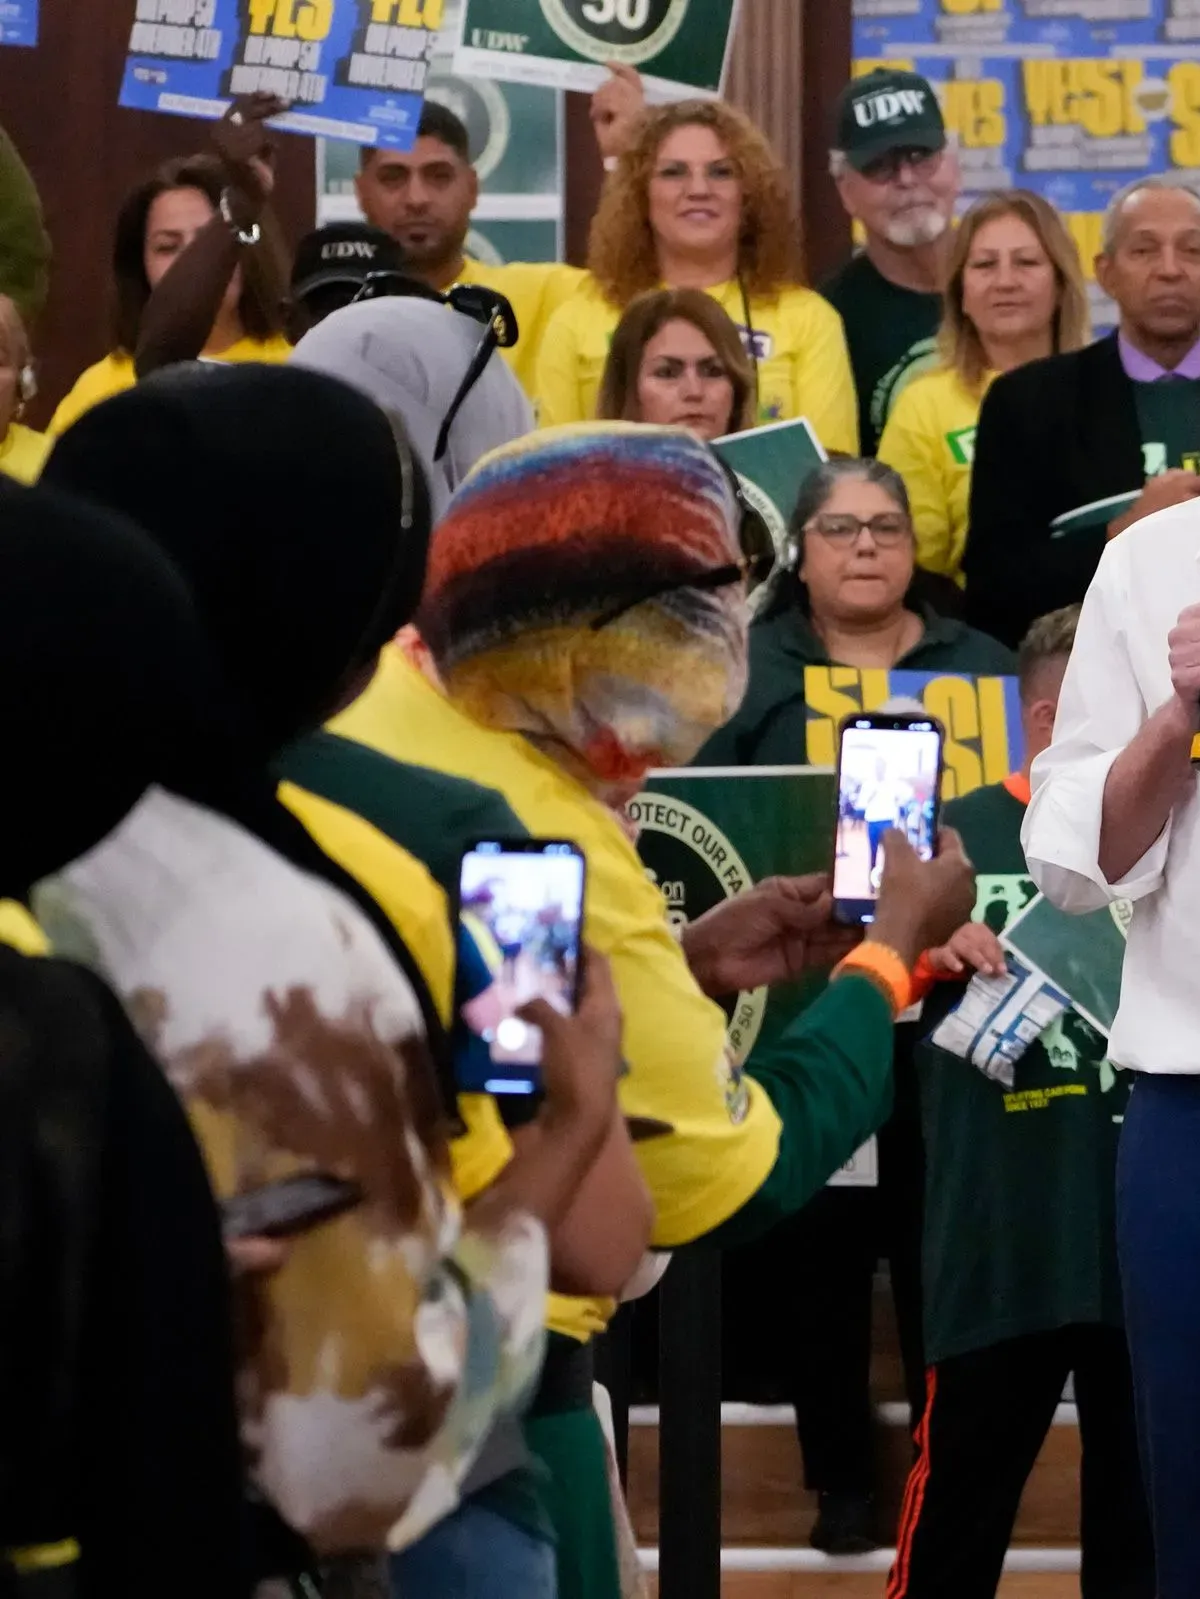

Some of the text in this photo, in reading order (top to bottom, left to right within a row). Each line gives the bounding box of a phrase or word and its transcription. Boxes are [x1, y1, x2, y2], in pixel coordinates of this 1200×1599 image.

[471, 28, 529, 51] UDW
[853, 89, 925, 128] UDW
[321, 241, 378, 260] UDW
[628, 802, 691, 834] OTECT
[691, 824, 728, 862] OUR
